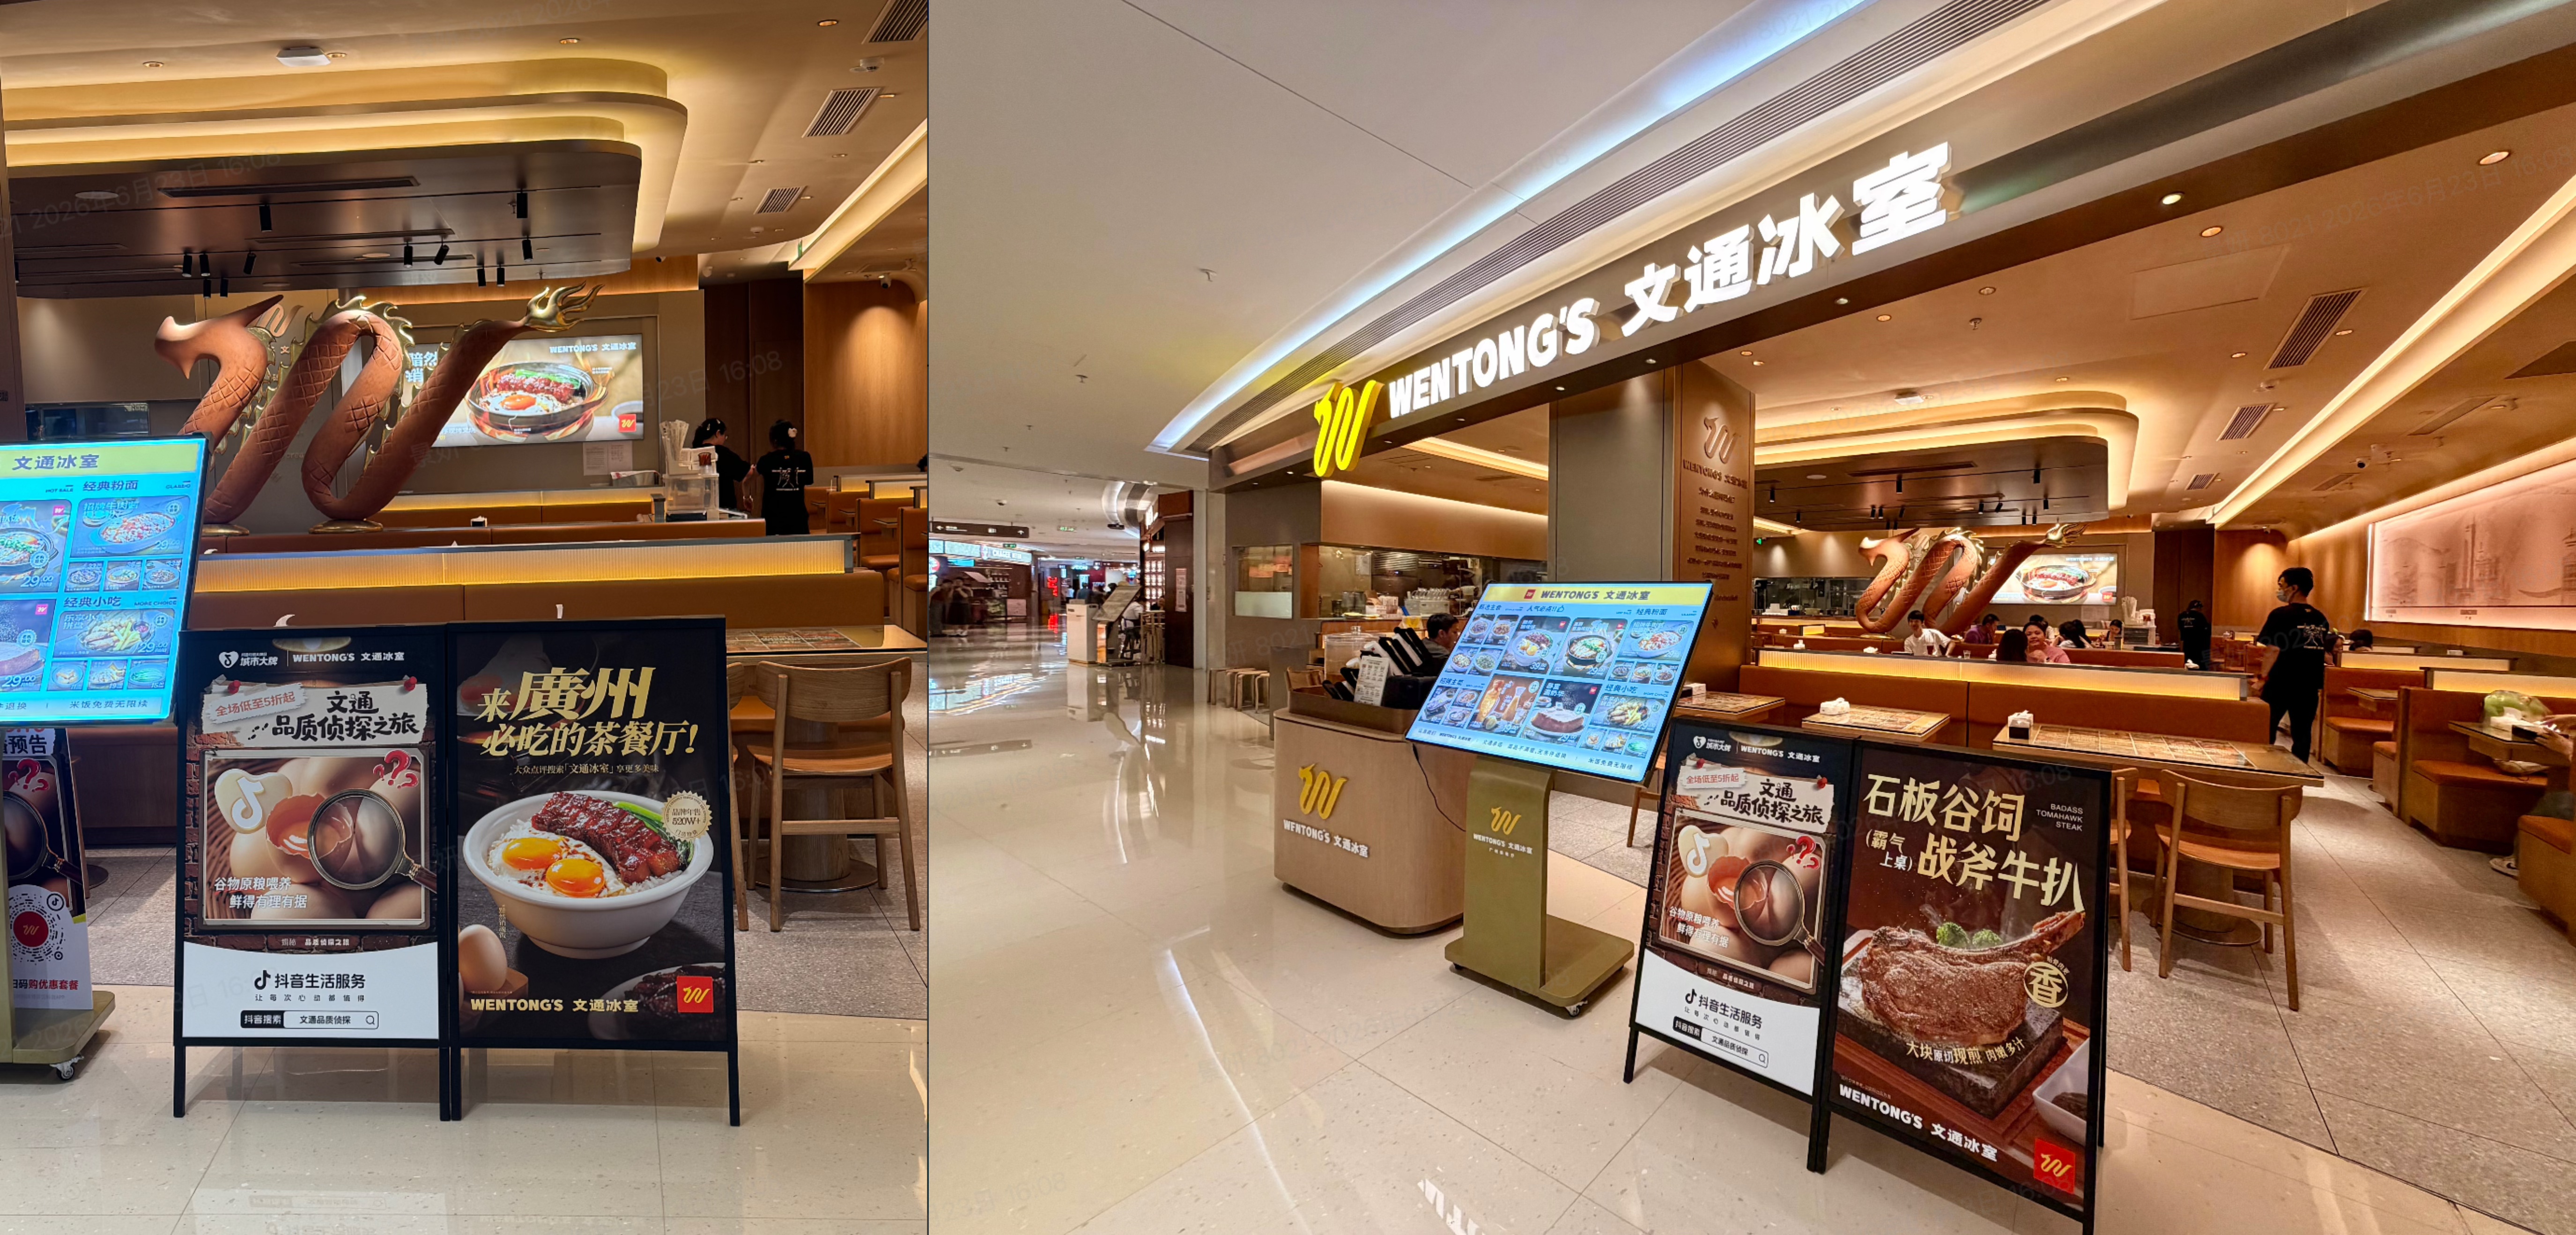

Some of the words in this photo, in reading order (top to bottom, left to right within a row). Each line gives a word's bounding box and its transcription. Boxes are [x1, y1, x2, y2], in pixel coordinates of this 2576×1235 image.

[1389, 296, 1599, 417] WENTONG'S
[1622, 141, 1950, 336] 文通冰室
[549, 343, 598, 353] WENTONG'S
[12, 454, 99, 470] 文通冰室
[83, 480, 139, 491] 经典粉面
[64, 596, 121, 608] 经典小吃
[1540, 590, 1599, 600] WENTONG'S
[1603, 591, 1651, 601] 文通冰室
[240, 656, 278, 667] 城市大牌
[293, 653, 355, 662] WENTONG'S
[361, 652, 405, 662] 文通冰室
[1605, 684, 1638, 694] 经典小吃
[70, 700, 148, 709] 米饭免费无限续
[215, 691, 296, 717] 全场低至5折起
[326, 691, 378, 714] 文通
[272, 712, 420, 742] 品质侦探之旅
[1706, 743, 1732, 752] 城市大牌
[1741, 745, 1784, 758] WENTONG'S
[1787, 751, 1821, 763] 文通冰室
[1686, 774, 1740, 785] 全场低至5折起
[1760, 779, 1797, 802] 文通
[1720, 790, 1825, 825] 品质侦探之旅
[1863, 774, 2025, 842] 石板谷饲
[2050, 803, 2084, 815] BADASS
[672, 817, 701, 825] 520W+
[2036, 809, 2084, 823] TOMAHAWK
[2055, 821, 2083, 832] STEAK
[1283, 819, 1330, 844] WENTONG'S
[1333, 835, 1369, 858] 文通冰室
[1473, 833, 1506, 848] WENTONG'S
[1917, 833, 2085, 913] 战斧牛扒
[214, 877, 291, 891] 谷物原粮喂养
[229, 895, 308, 909] 鲜得有理有据
[1669, 906, 1720, 930] 谷物原粮喂养
[1676, 922, 1729, 949] 鲜得有理有据
[274, 973, 366, 989] 抖音生活服务
[2028, 963, 2063, 1004] 香
[471, 999, 564, 1012] WENTONG'S
[572, 999, 639, 1012] 文通冰室
[1698, 994, 1763, 1030] 抖音生活服务
[244, 1014, 281, 1025] 抖音搜索
[299, 1015, 351, 1025] 文通品质侦探
[1906, 1041, 1983, 1065] 大块原切现煎
[1986, 1036, 2026, 1063] 肉嫩多汁
[1839, 1083, 1923, 1130] WENTONG'S
[1931, 1123, 1998, 1162] 文通冰室
